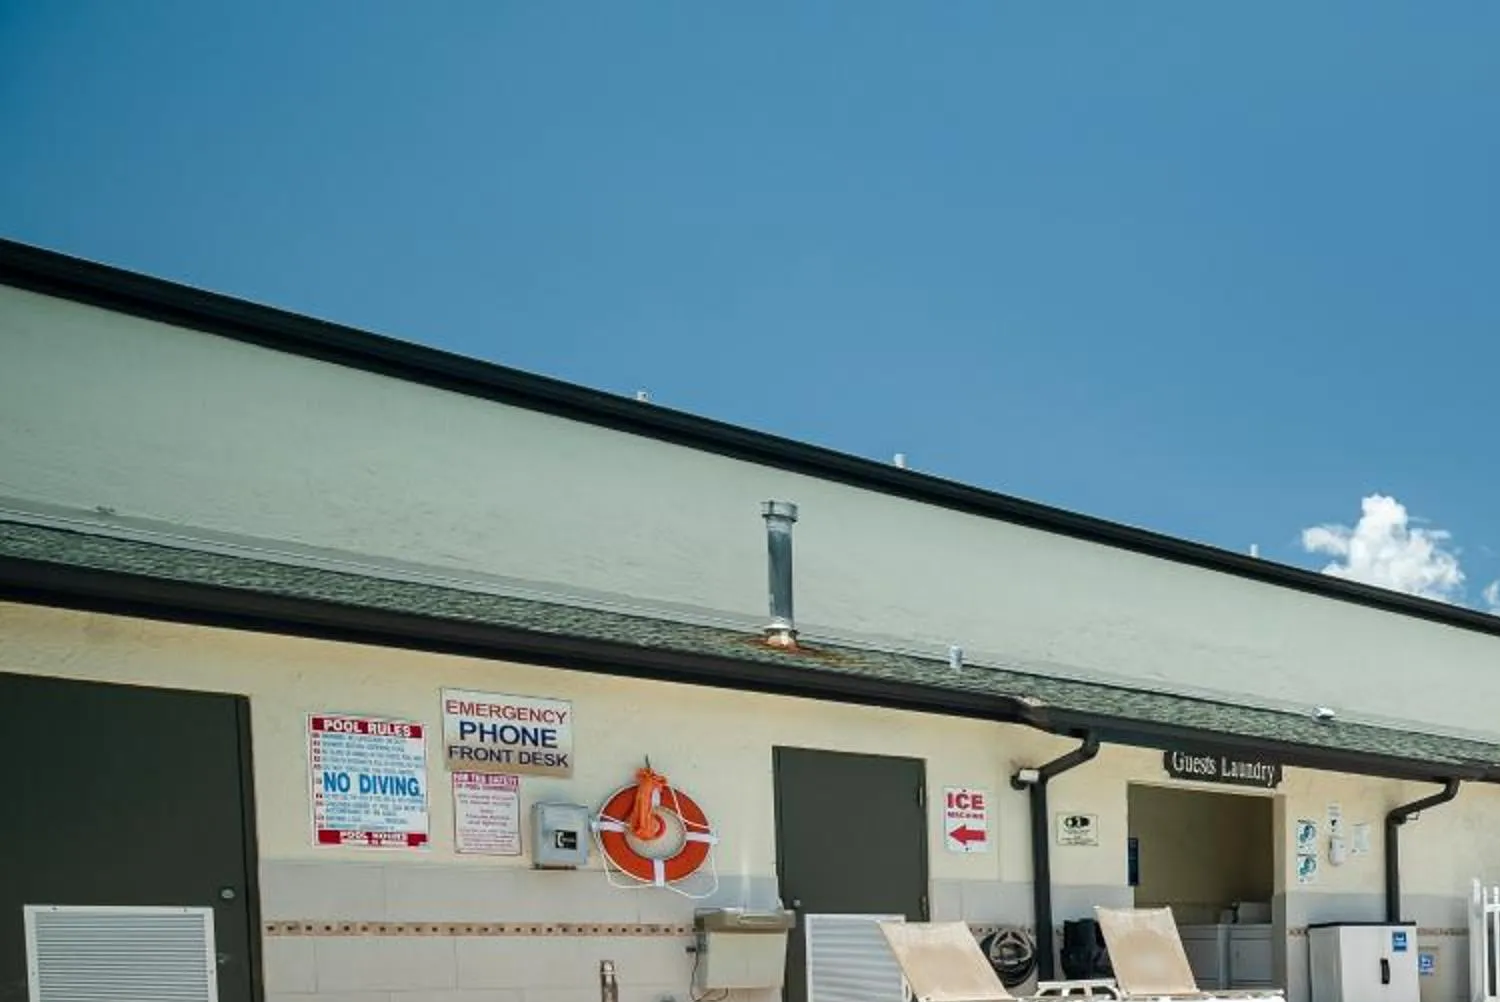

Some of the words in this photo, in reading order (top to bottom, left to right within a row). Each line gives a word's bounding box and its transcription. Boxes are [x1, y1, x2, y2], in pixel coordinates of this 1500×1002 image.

[446, 700, 567, 725] EMERGENCY
[323, 719, 363, 733] POOL
[367, 721, 411, 737] RULES
[459, 721, 558, 749] PHONE
[448, 745, 514, 763] FRONT
[518, 751, 569, 768] DESK
[1172, 751, 1217, 775] Guests
[1221, 756, 1275, 787] Laundry
[323, 772, 350, 793] NO
[947, 792, 985, 810] ICE
